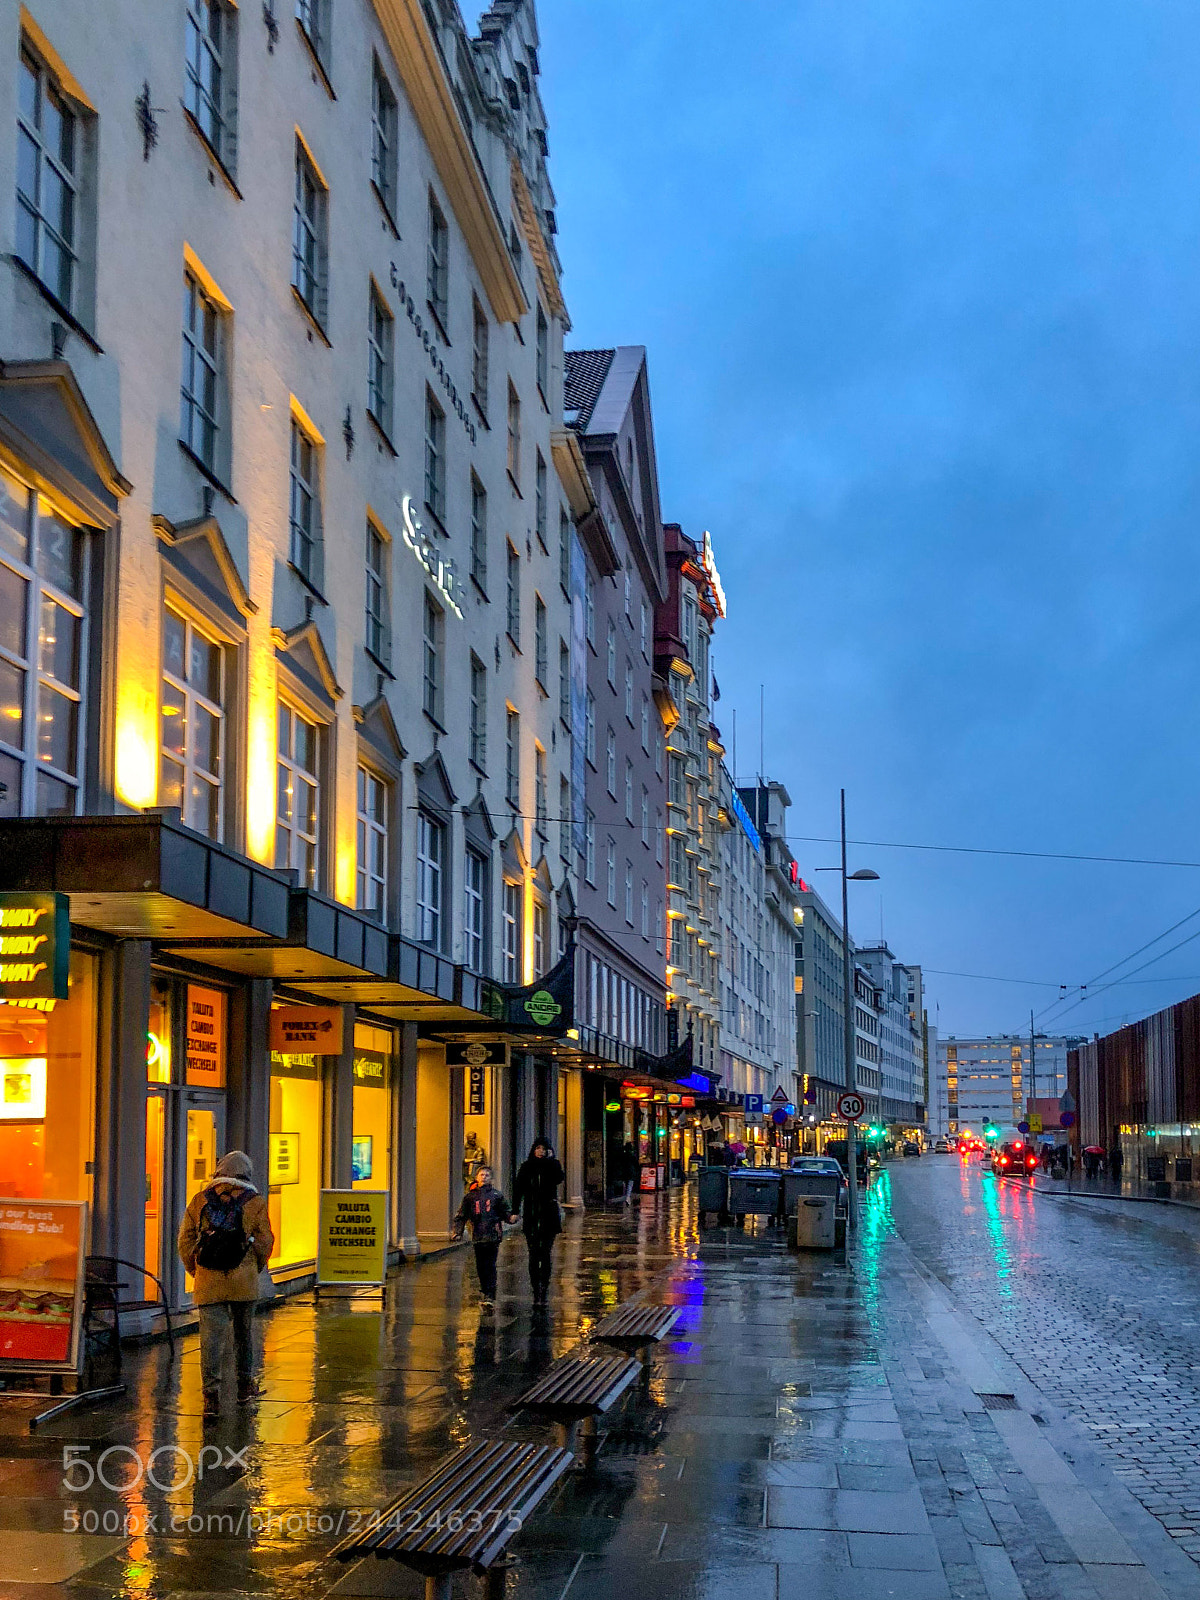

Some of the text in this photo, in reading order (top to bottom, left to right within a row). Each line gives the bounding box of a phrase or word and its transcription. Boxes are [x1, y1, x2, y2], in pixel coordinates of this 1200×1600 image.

[192, 1002, 213, 1017] VALUTA
[191, 1020, 213, 1035] CAMBIO
[282, 1022, 319, 1031] FOREX
[285, 1032, 316, 1042] BANK
[187, 1037, 217, 1053] EXCHANGE
[187, 1056, 216, 1071] WECHSELN
[471, 1067, 481, 1114] OTEL
[748, 1096, 759, 1110] P
[843, 1099, 860, 1114] 30
[337, 1203, 370, 1212] VALUTA
[335, 1215, 372, 1223] CAMBIO
[37, 1222, 64, 1233] Sub!
[329, 1226, 376, 1236] EXCHANGE
[328, 1238, 376, 1247] WECHSELN
